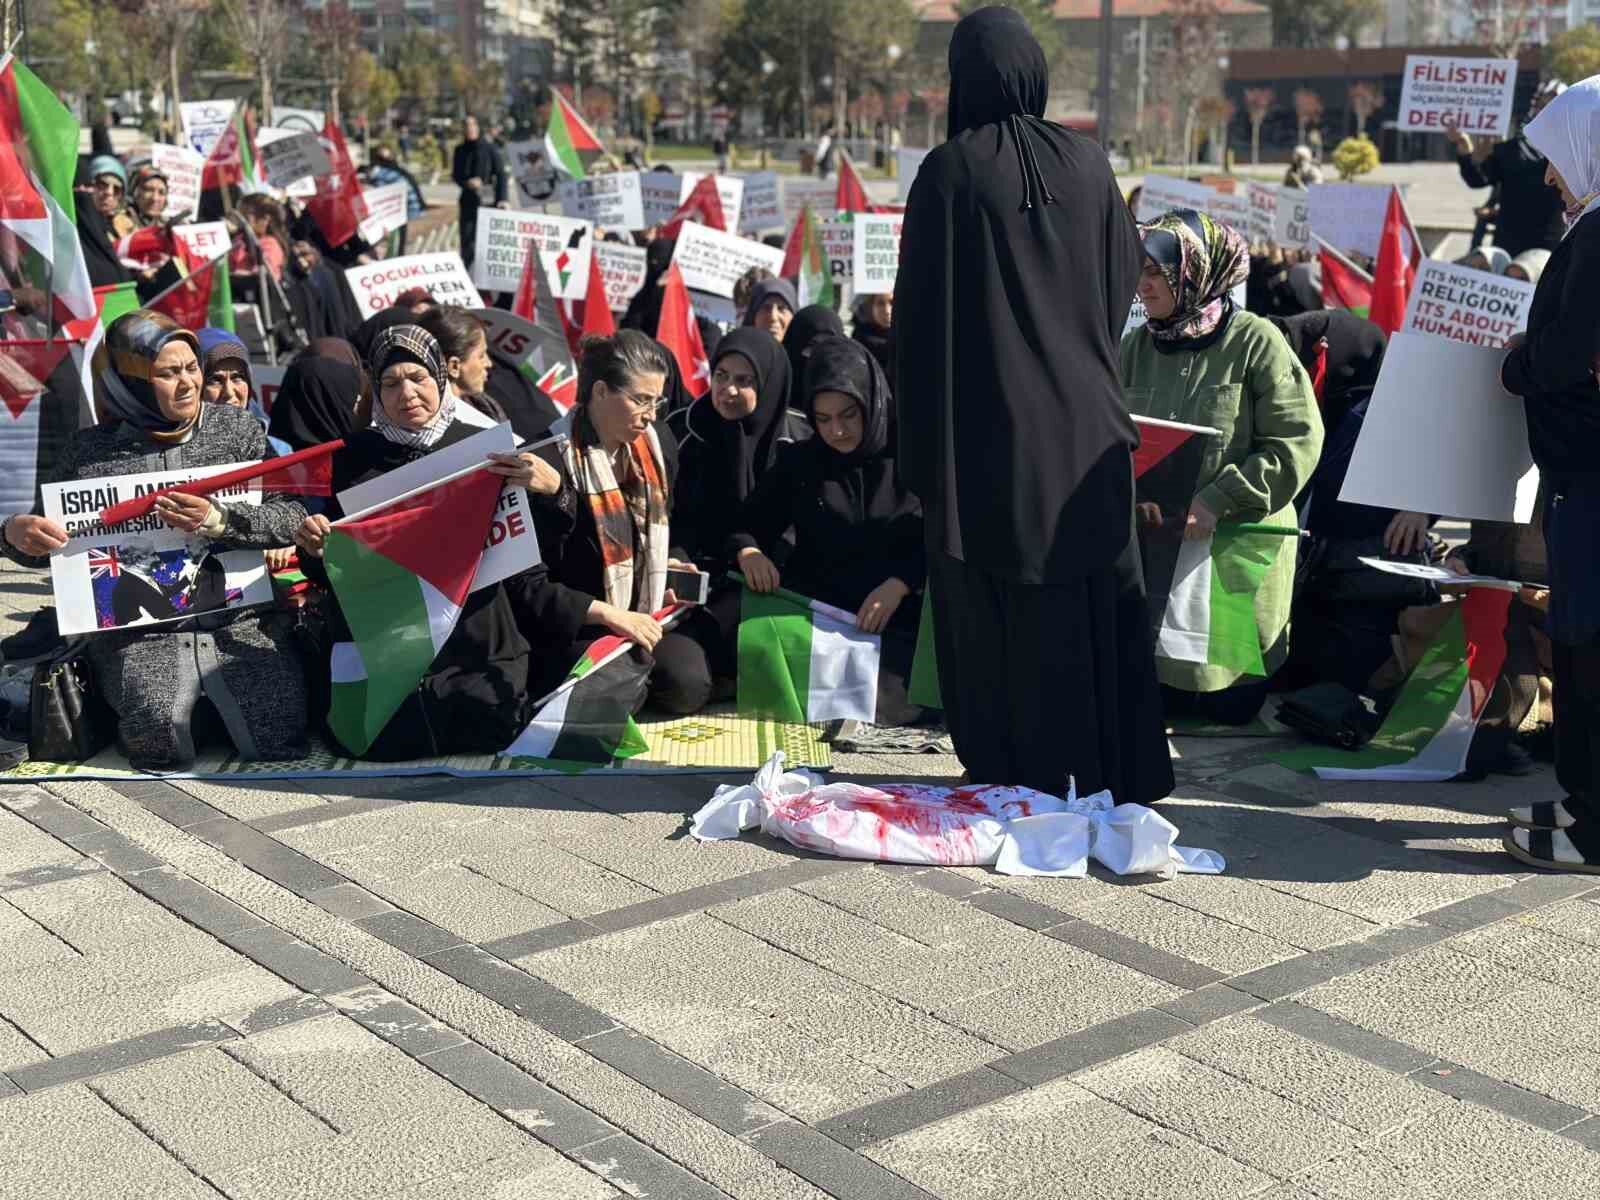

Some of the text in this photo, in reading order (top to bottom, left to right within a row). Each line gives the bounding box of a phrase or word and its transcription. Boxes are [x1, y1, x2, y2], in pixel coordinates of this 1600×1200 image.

[1413, 61, 1507, 85] FİLİSTİN
[1407, 106, 1499, 130] DEĞİLİZ
[489, 217, 516, 232] ORTA
[360, 262, 456, 290] ÇOCUKLAR
[830, 259, 855, 277] R!
[1425, 268, 1529, 302] ITS NOT ABOUT
[1416, 300, 1518, 337] ITS ABOUT
[493, 327, 531, 355] IS
[59, 483, 120, 515] İSRAİL
[484, 510, 526, 550] DE
